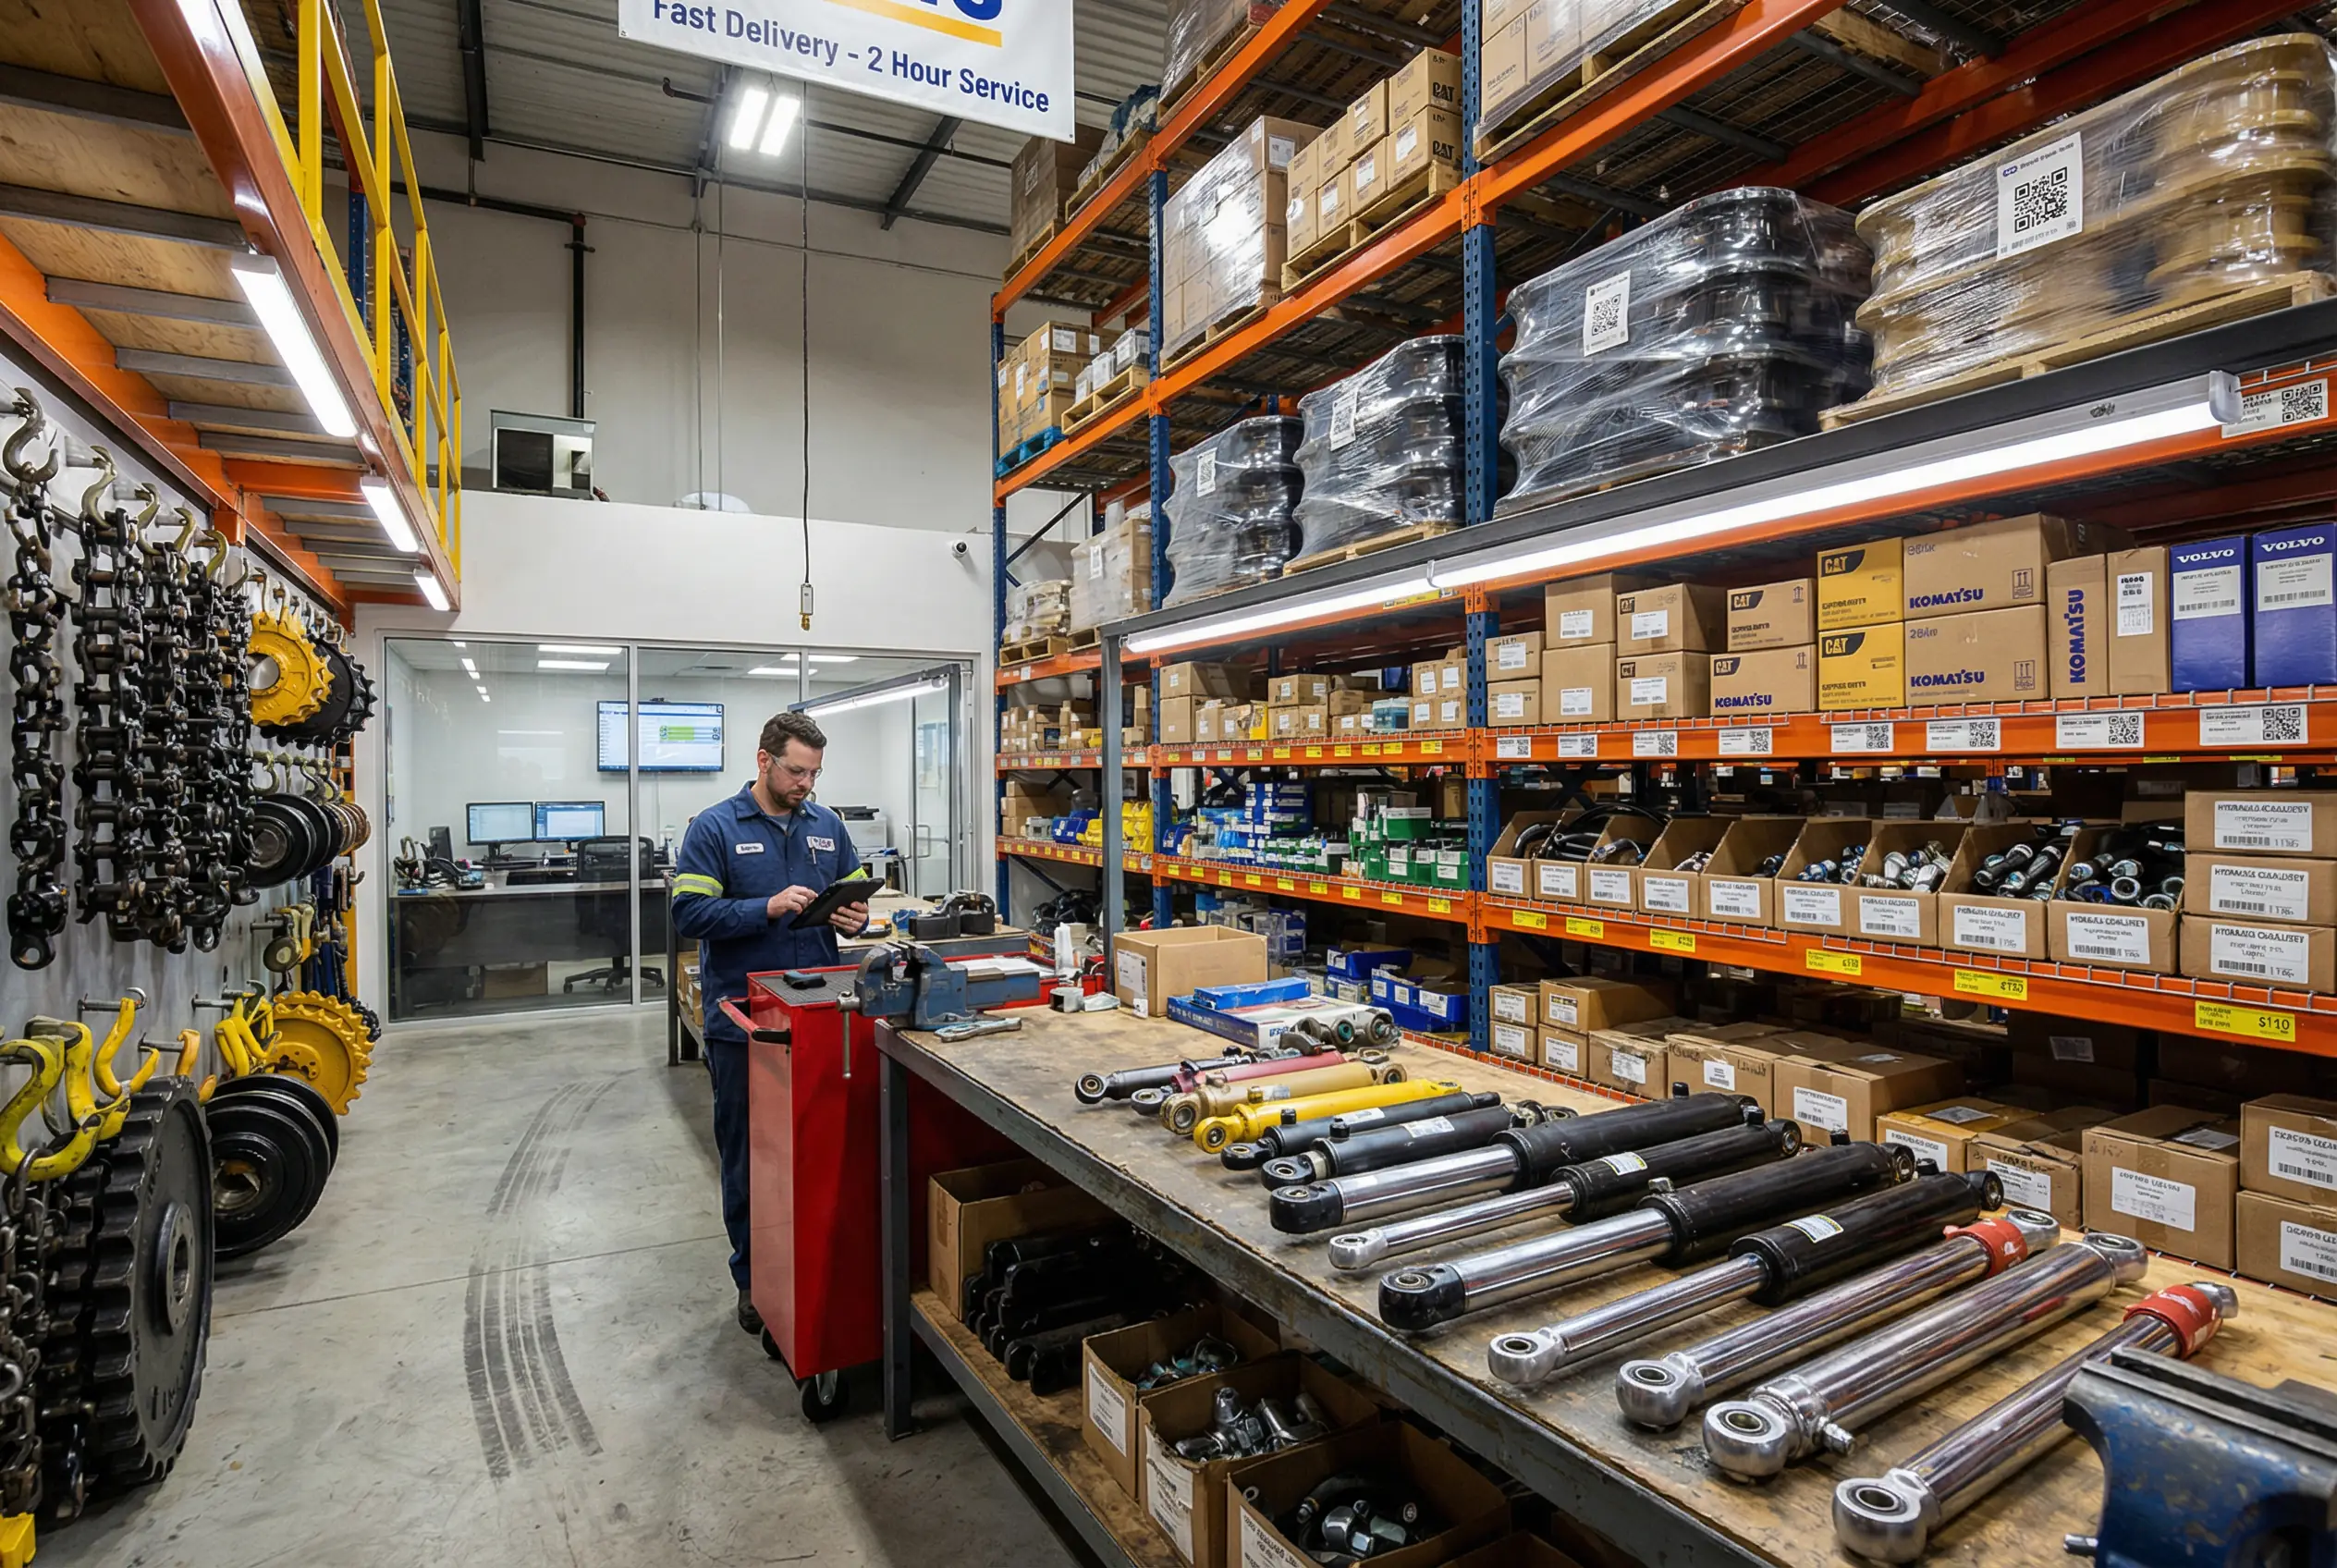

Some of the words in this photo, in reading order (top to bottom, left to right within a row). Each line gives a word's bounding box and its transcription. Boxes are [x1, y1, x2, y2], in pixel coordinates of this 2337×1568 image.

[654, 0, 716, 33] Fast
[725, 10, 839, 67] Delivery
[847, 51, 859, 60] -
[867, 47, 884, 73] 2
[891, 52, 952, 88] Hour
[959, 68, 1050, 113] Service
[2261, 536, 2325, 552] VOLVO
[2176, 548, 2234, 563] VOLVO
[1825, 556, 1848, 574] CAT
[1909, 588, 1984, 609] KOMATSU
[2064, 590, 2086, 683] KOMATSU
[1825, 637, 1848, 655] CAT
[1910, 669, 1985, 688] KOMATSU
